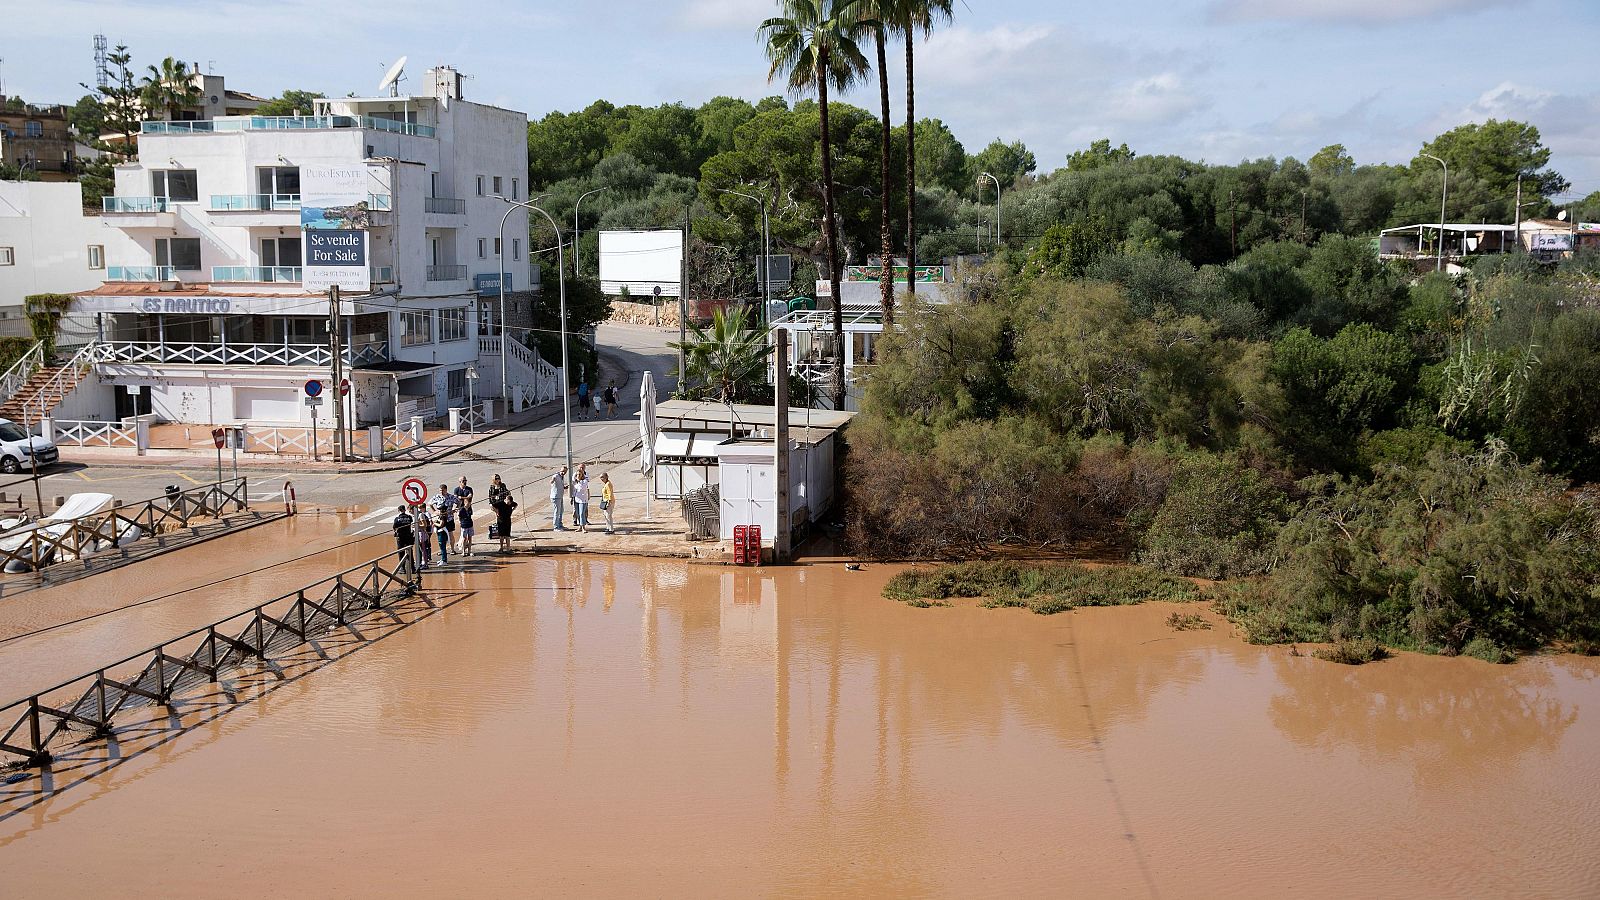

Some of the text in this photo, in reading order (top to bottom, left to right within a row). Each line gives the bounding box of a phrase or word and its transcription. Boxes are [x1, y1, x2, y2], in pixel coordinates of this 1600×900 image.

[311, 233, 360, 246] Se vende
[313, 249, 358, 261] For Sale
[143, 298, 230, 312] ES NAUTICO
